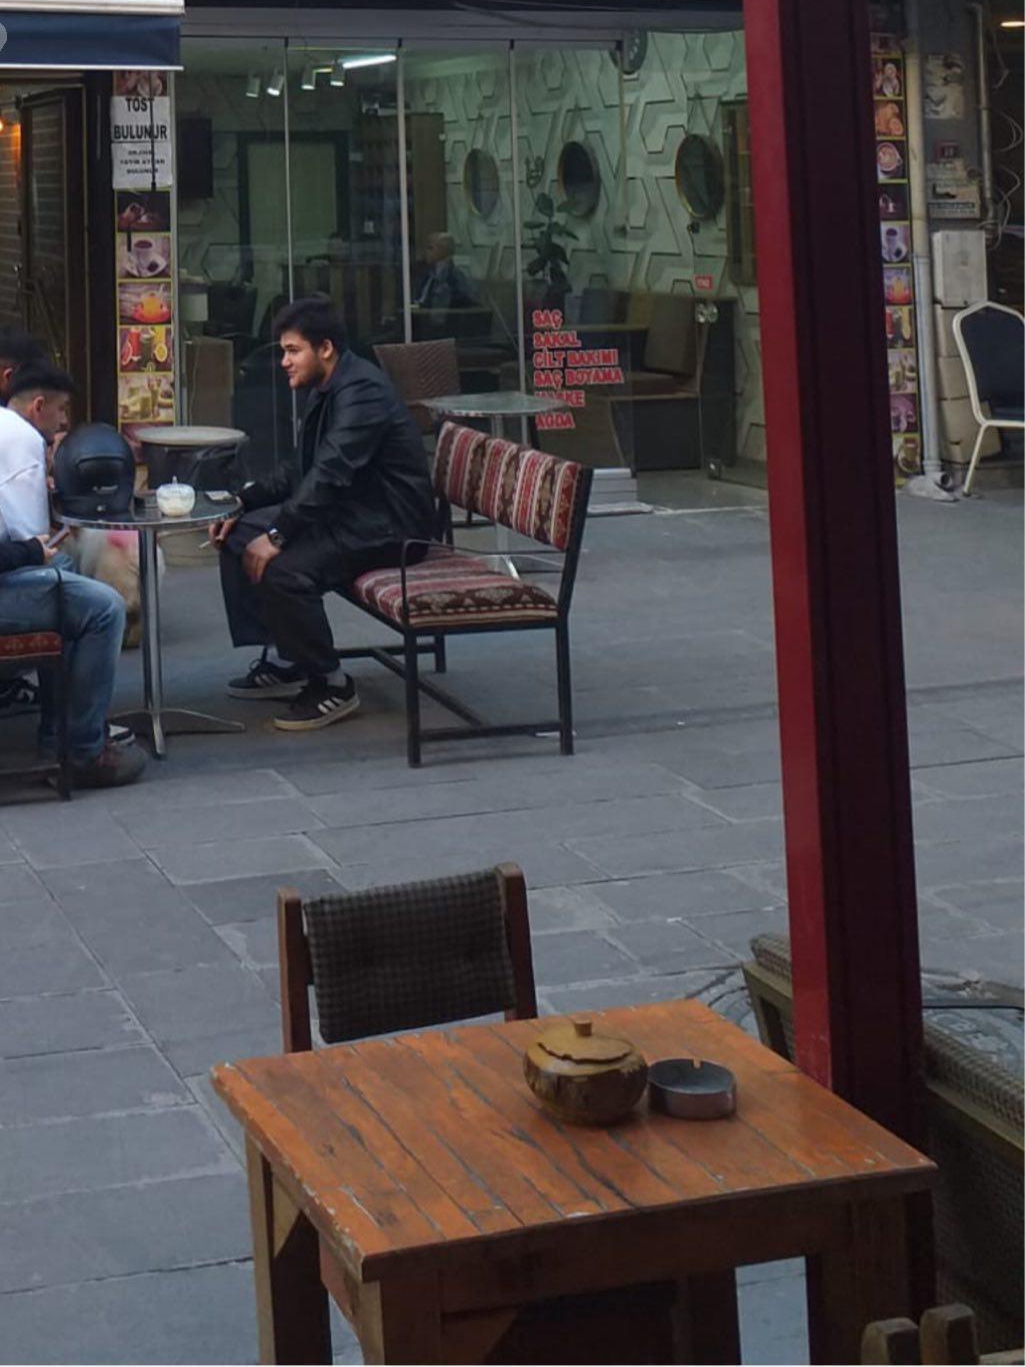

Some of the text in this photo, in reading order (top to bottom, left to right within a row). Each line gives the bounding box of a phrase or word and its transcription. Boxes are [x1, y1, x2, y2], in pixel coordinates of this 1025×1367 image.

[126, 97, 154, 112] TOST
[114, 124, 168, 140] BULUNUR
[532, 309, 563, 329] SAÇ
[532, 331, 581, 348] SAKAL
[533, 367, 624, 389] SAÇ BOYAMA
